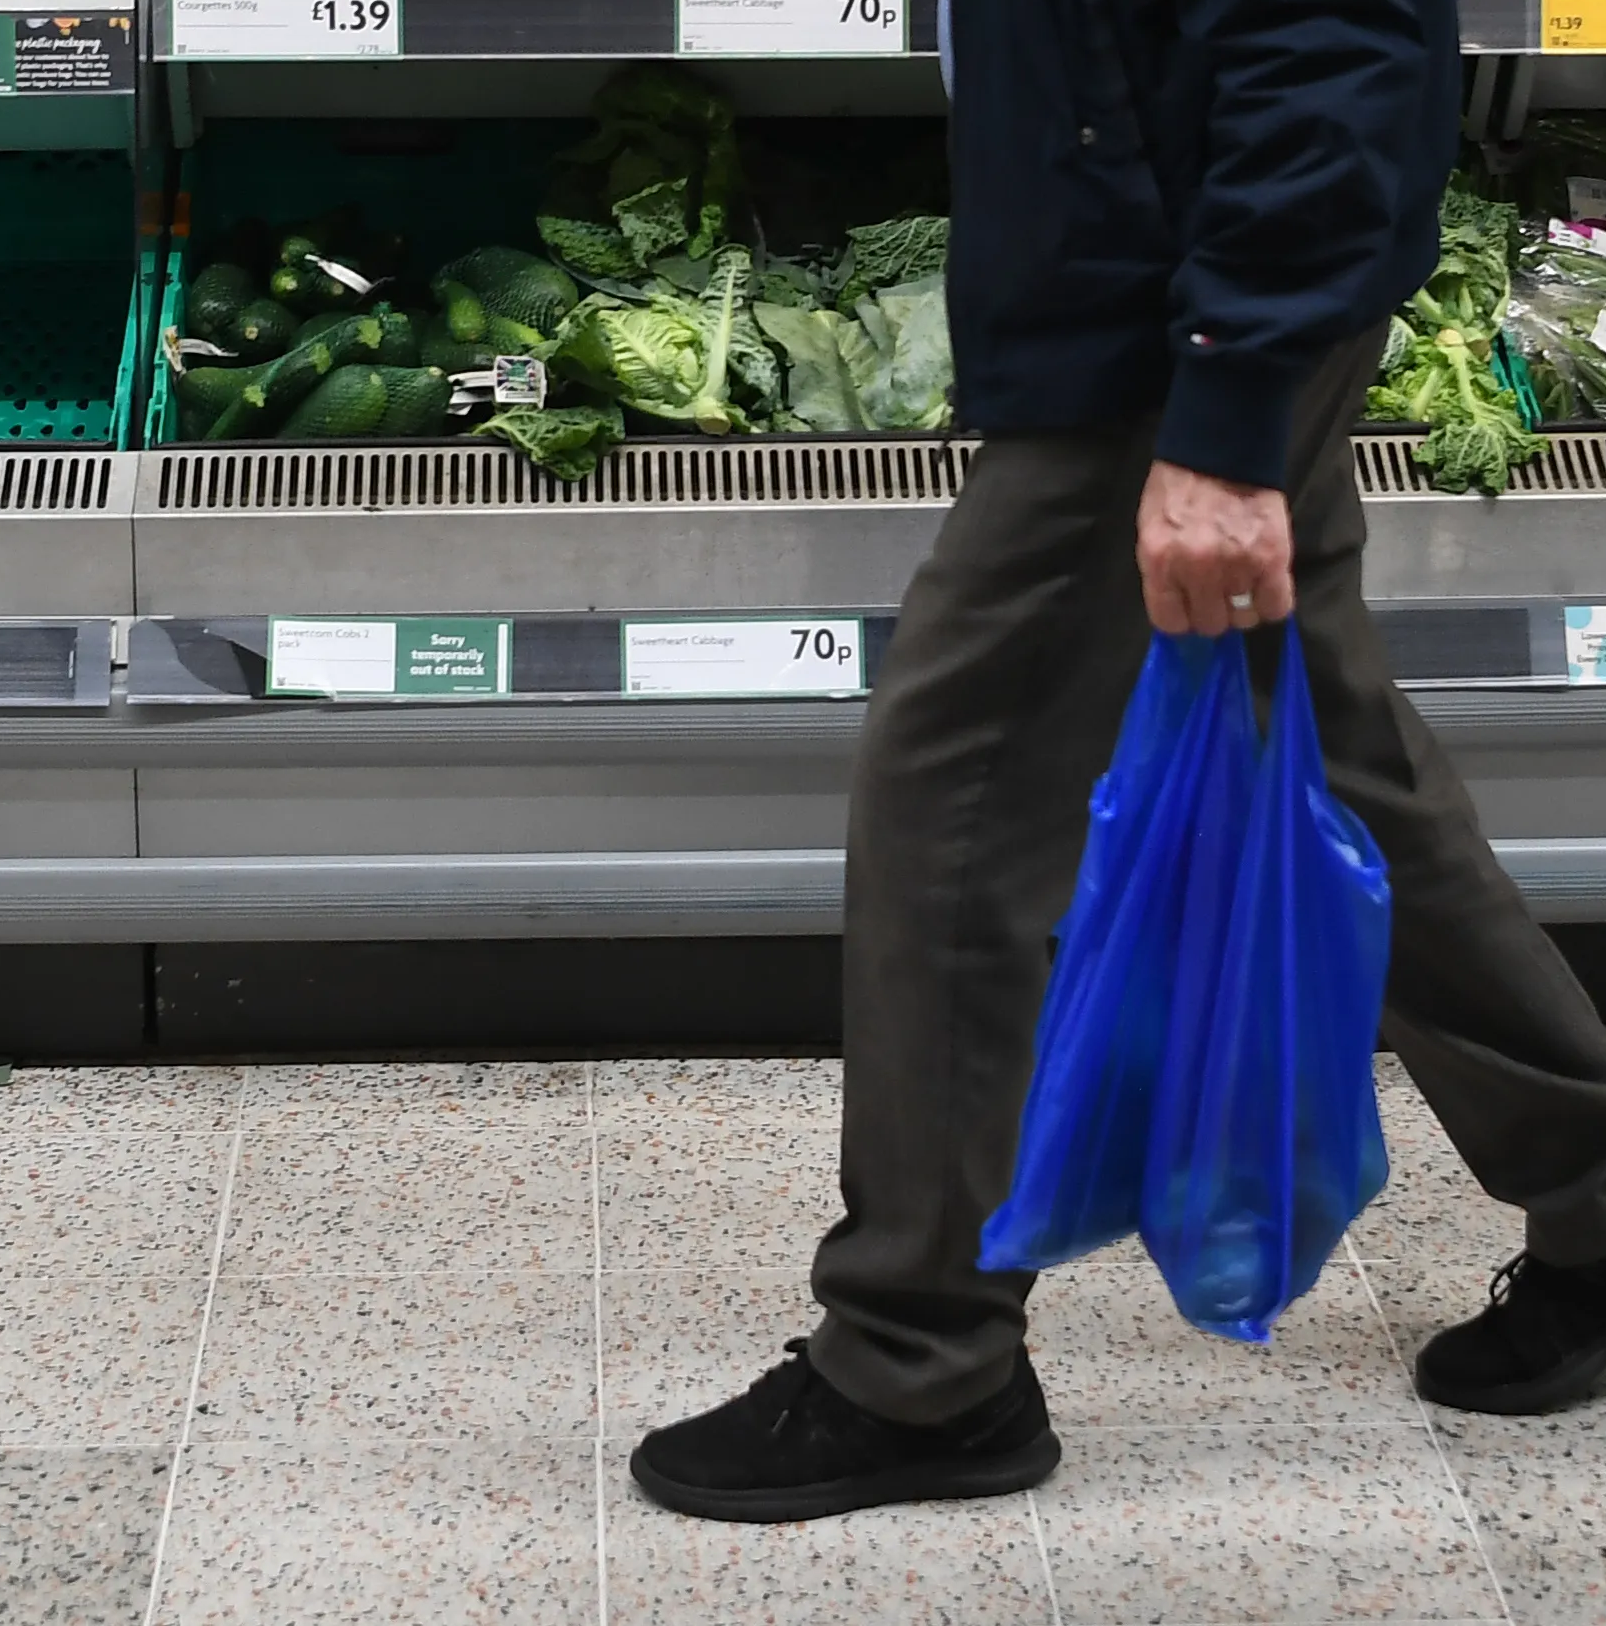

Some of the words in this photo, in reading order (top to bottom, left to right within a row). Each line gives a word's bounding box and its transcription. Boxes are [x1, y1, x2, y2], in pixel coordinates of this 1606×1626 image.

[177, 1, 231, 13] Courgettes
[313, 0, 389, 30] £1.39
[1549, 18, 1582, 31] £1.39
[277, 627, 335, 639] Sweetcorn
[337, 627, 362, 639] Cobs
[277, 639, 301, 651] pack
[430, 633, 466, 649] Sorry
[630, 635, 689, 647] Sweetheart
[690, 636, 735, 649] Cabbage
[791, 629, 851, 665] 70p
[411, 648, 484, 664] temporarily
[410, 665, 431, 677] out
[434, 662, 449, 676] of
[451, 662, 485, 676] stock
